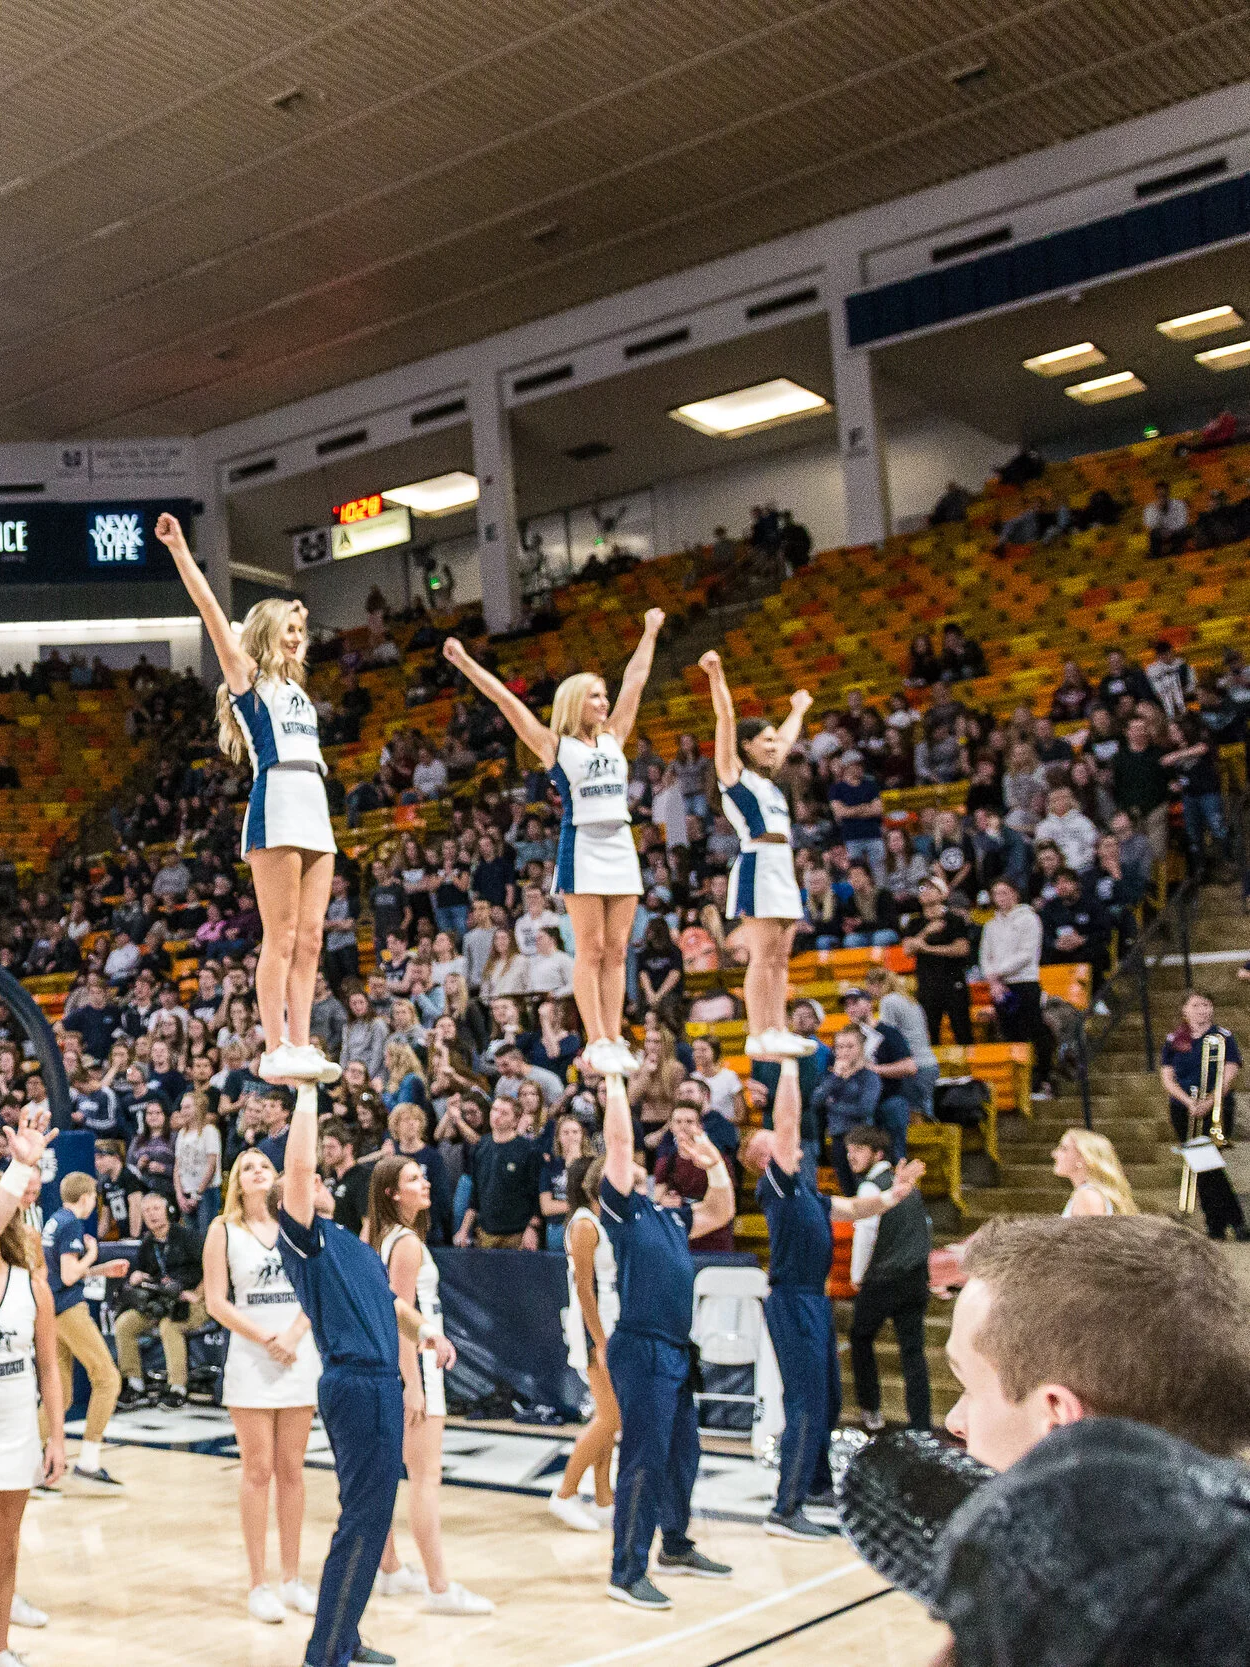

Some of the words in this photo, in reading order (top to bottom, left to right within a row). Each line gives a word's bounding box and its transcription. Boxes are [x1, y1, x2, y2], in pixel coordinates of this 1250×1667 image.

[95, 514, 139, 531] NEW
[88, 527, 145, 546] YORK
[96, 545, 139, 562] LIFE
